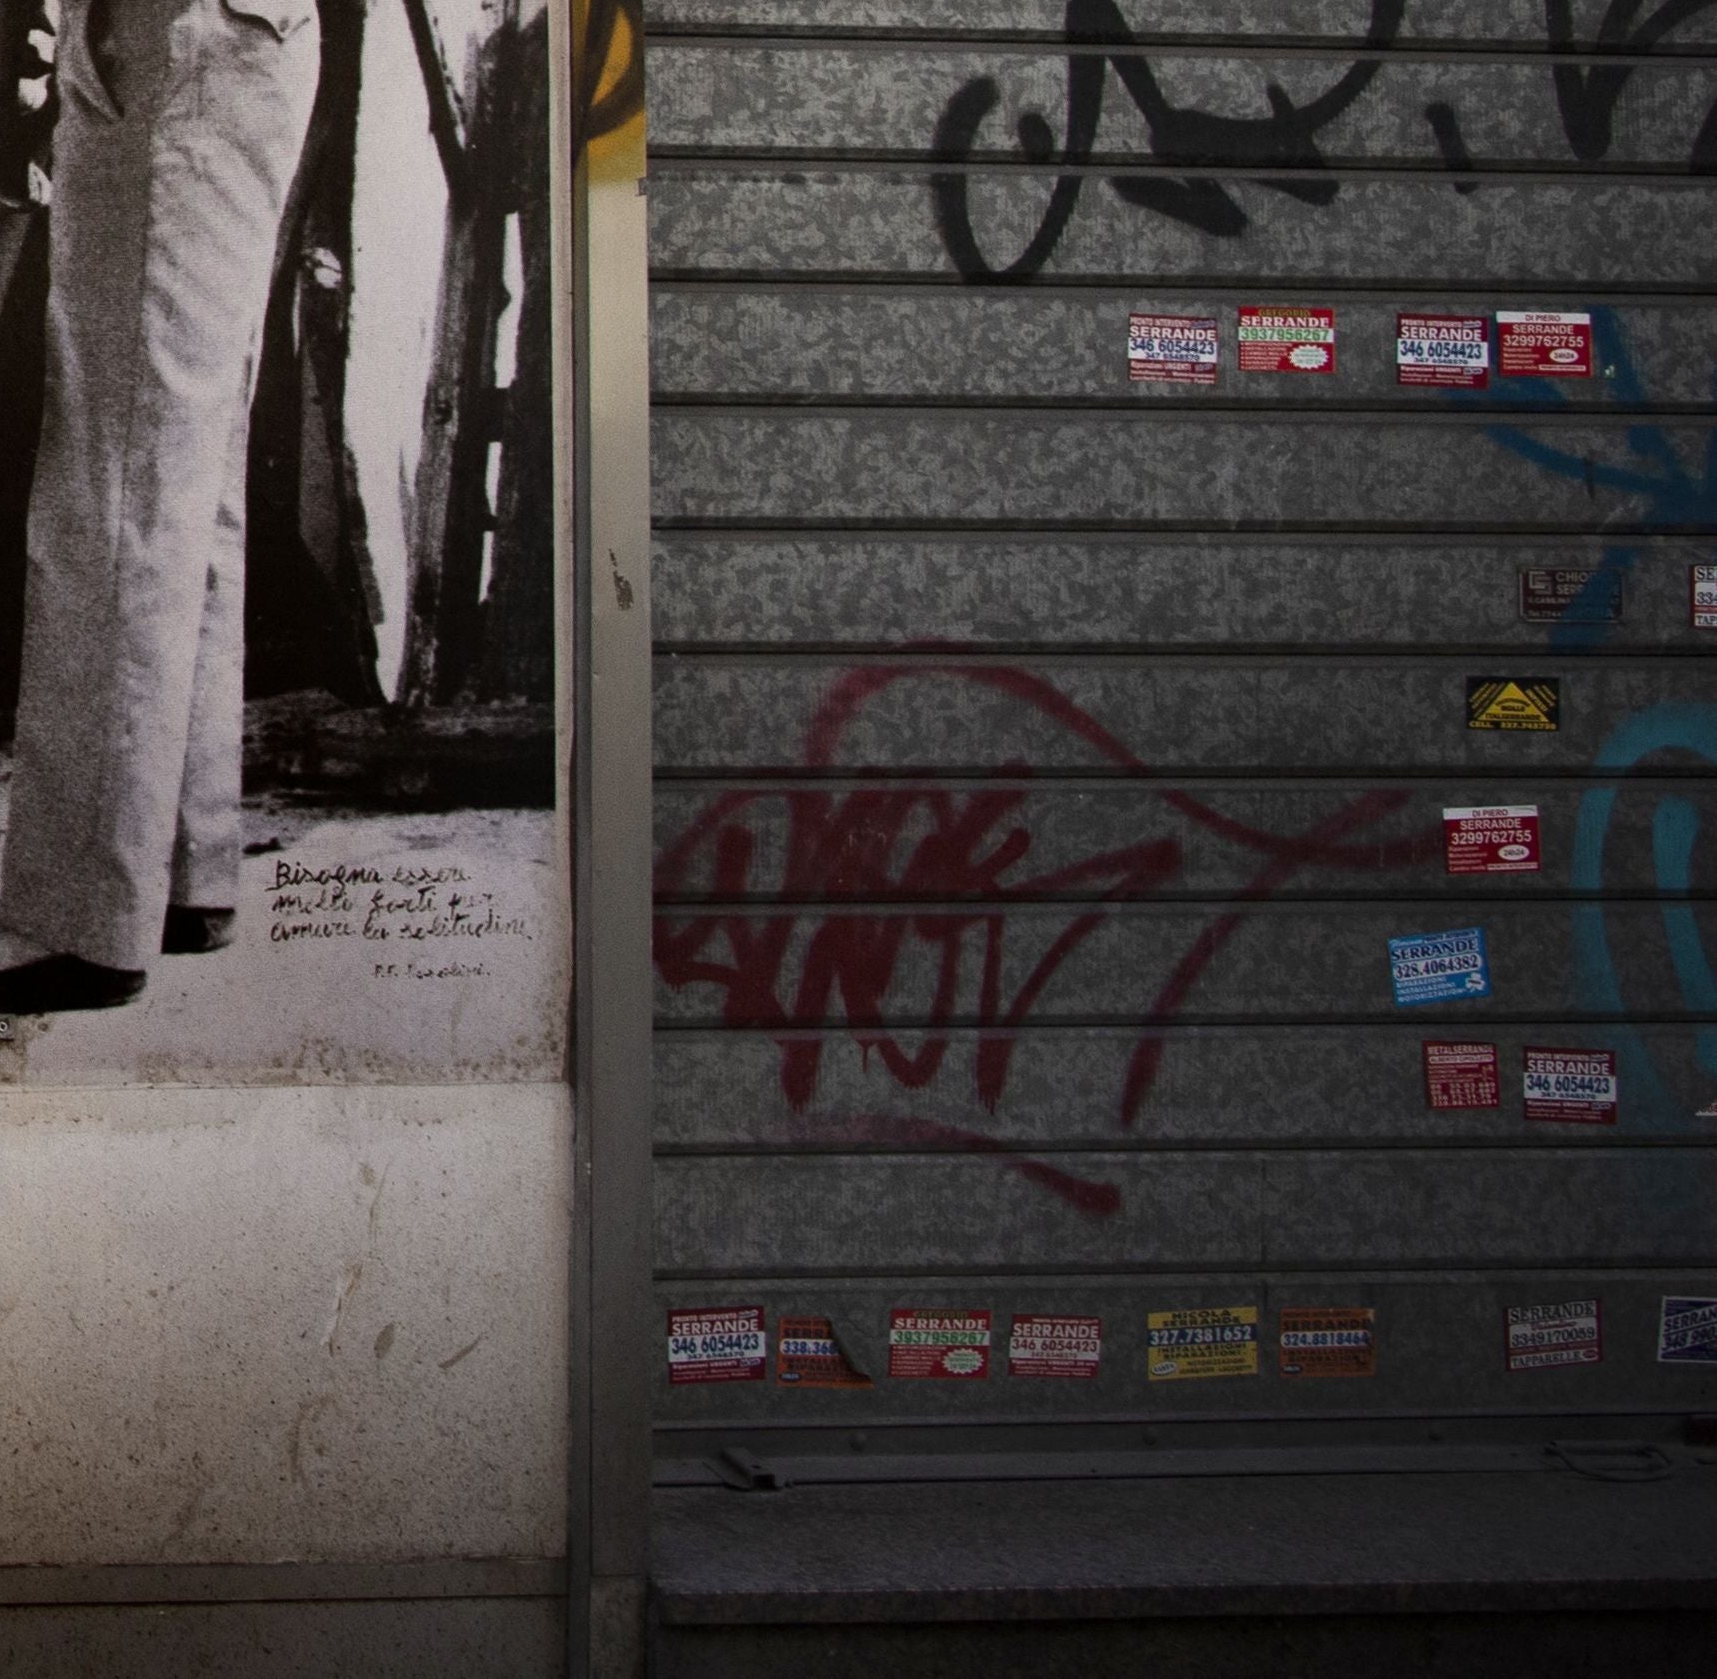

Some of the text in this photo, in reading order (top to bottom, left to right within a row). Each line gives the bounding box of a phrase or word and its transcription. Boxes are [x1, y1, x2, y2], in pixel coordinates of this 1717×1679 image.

[1240, 316, 1329, 328] SERRANDE
[1525, 314, 1561, 323] DI PIERO
[1129, 325, 1216, 342] SERRANDE
[1241, 328, 1329, 341] 3937956267
[1400, 326, 1482, 342] SERRANDE
[1512, 324, 1575, 335] SERRANDE
[1129, 338, 1215, 355] 346 6054423
[1502, 334, 1584, 348] 3299762755
[1399, 341, 1482, 360] 346 6054423
[1472, 809, 1509, 818] DI PIERO
[1459, 818, 1522, 831] SERRANDE
[1450, 830, 1533, 845] 3299762755
[266, 860, 383, 892] Bisogna
[1391, 938, 1478, 962] SERRANDE
[1397, 954, 1480, 980] 328.4064382
[1527, 1060, 1610, 1075] SERRANDE
[1527, 1075, 1610, 1094] 346 6054423
[1172, 1310, 1232, 1321] NICOLA
[1510, 1302, 1594, 1324] SERRANDE
[671, 1319, 759, 1336] SERRANDE
[894, 1318, 988, 1331] SERRANDE
[1163, 1316, 1242, 1328] SERRANDE
[894, 1331, 987, 1345] 3937956267
[1013, 1323, 1099, 1339] SERRANDE
[1150, 1324, 1252, 1346] 327.7381652
[671, 1333, 760, 1355] 346 6054423
[1012, 1339, 1097, 1353] 346 6054423
[1511, 1350, 1583, 1367] TAPPARELLE
